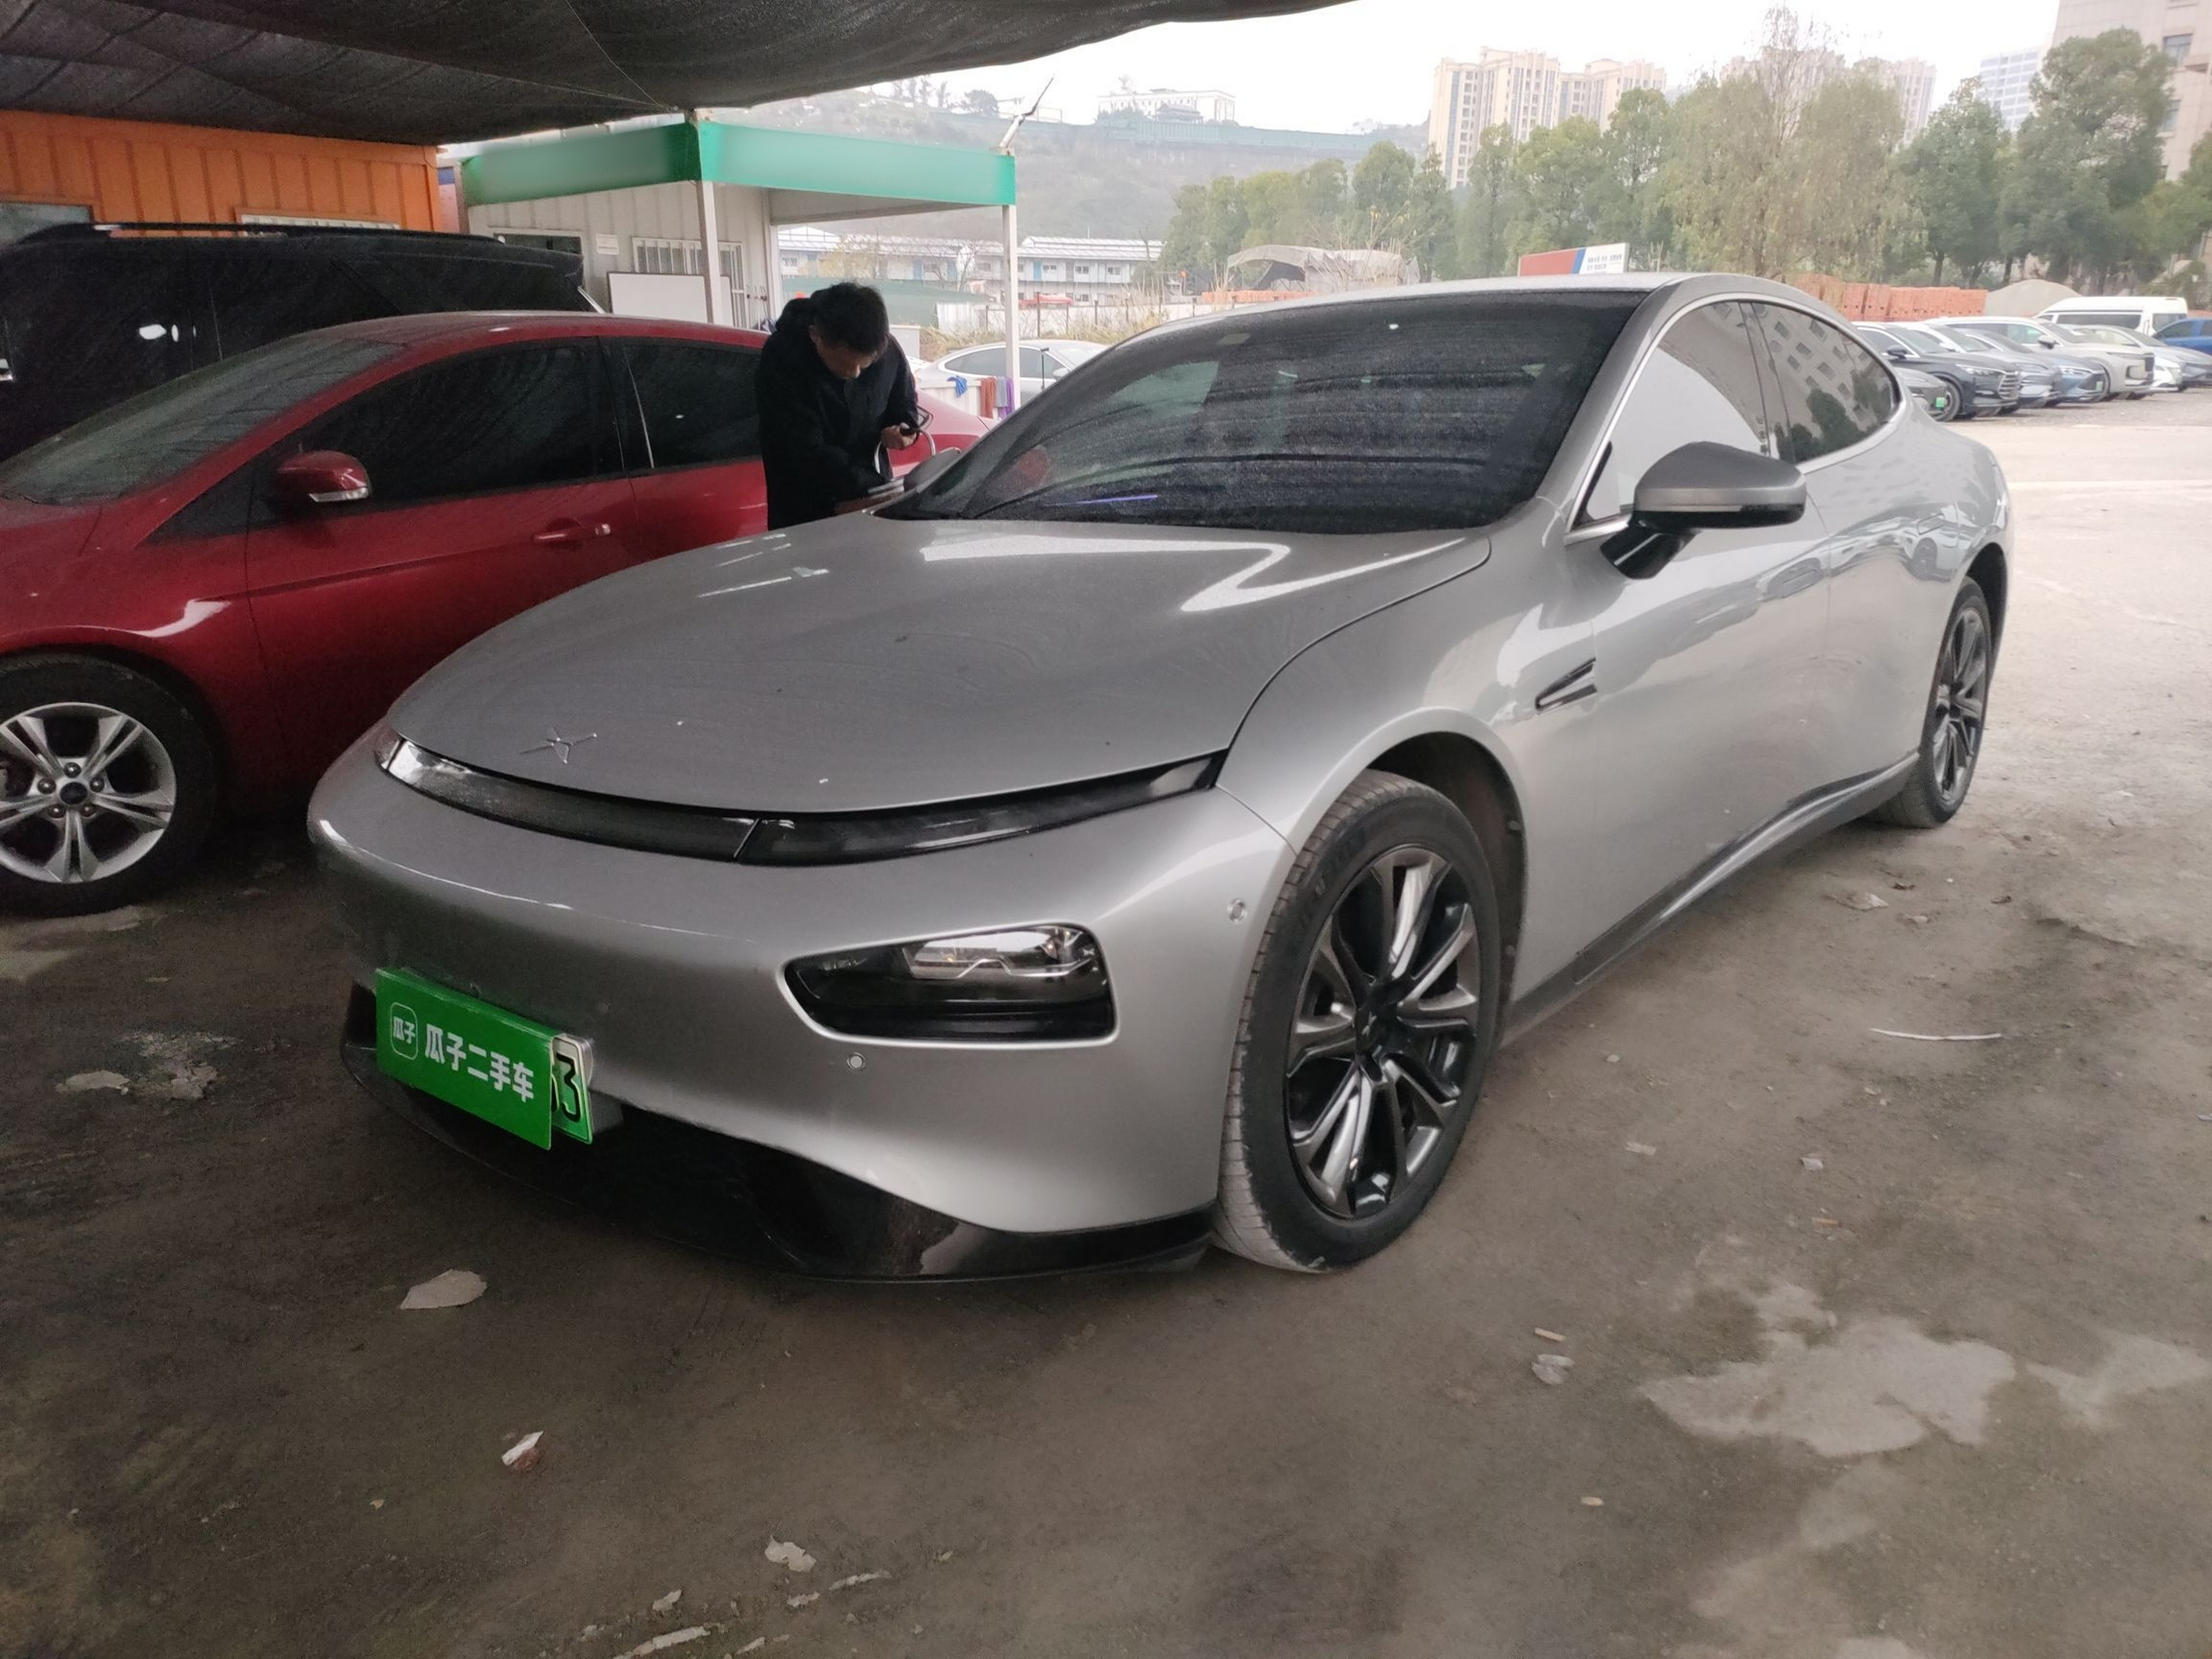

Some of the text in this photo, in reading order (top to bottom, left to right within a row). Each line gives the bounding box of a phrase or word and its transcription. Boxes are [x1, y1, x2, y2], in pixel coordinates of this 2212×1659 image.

[393, 1016, 415, 1044] 瓜子
[425, 1023, 534, 1103] 瓜子二手车
[551, 1052, 581, 1122] 3
